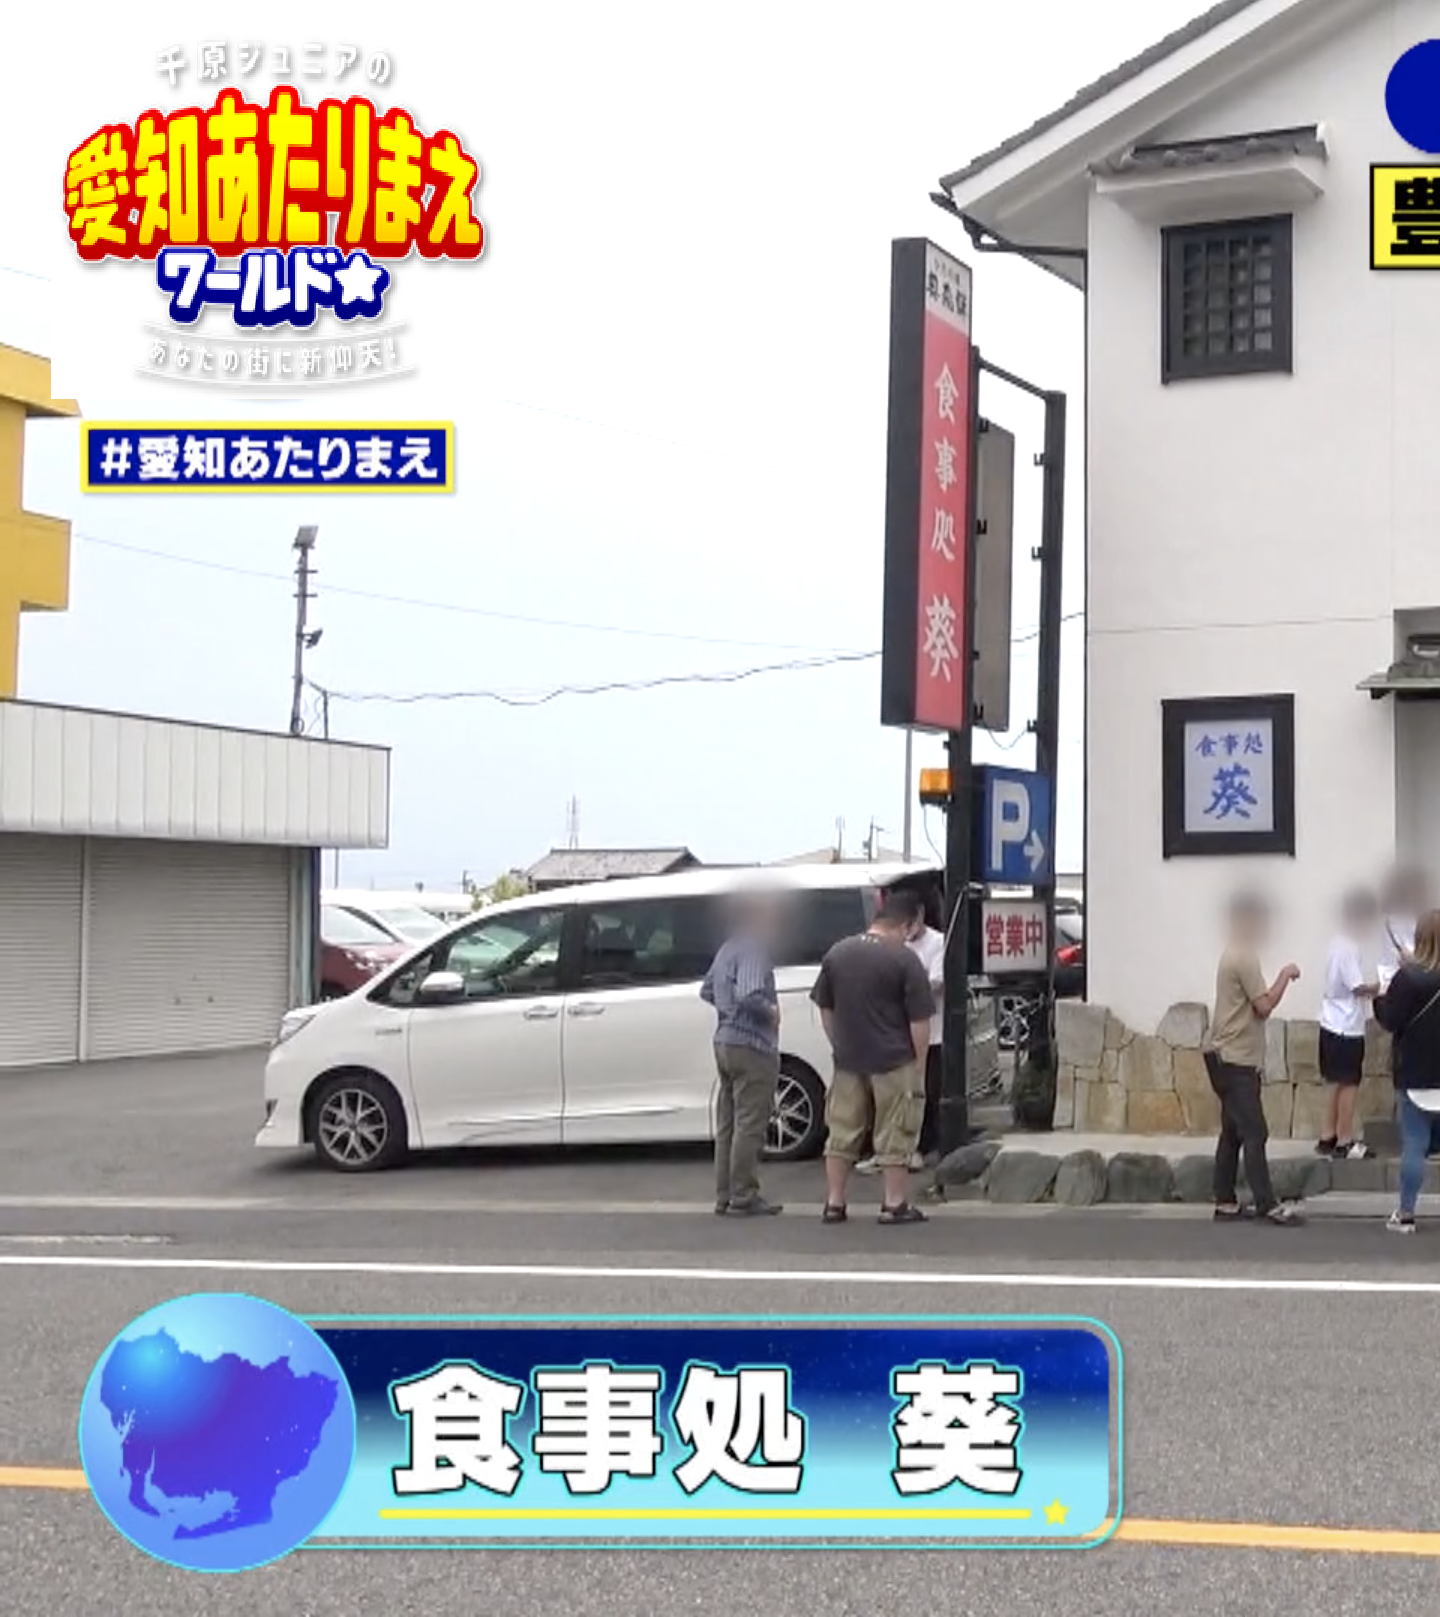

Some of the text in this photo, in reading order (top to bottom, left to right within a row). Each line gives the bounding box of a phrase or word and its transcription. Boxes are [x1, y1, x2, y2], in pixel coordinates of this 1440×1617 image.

[922, 362, 960, 684] 食事処 葵
[1195, 731, 1264, 757] 食事処
[1204, 763, 1258, 819] 葵
[991, 778, 1031, 871] P
[985, 913, 1043, 959] 営業中
